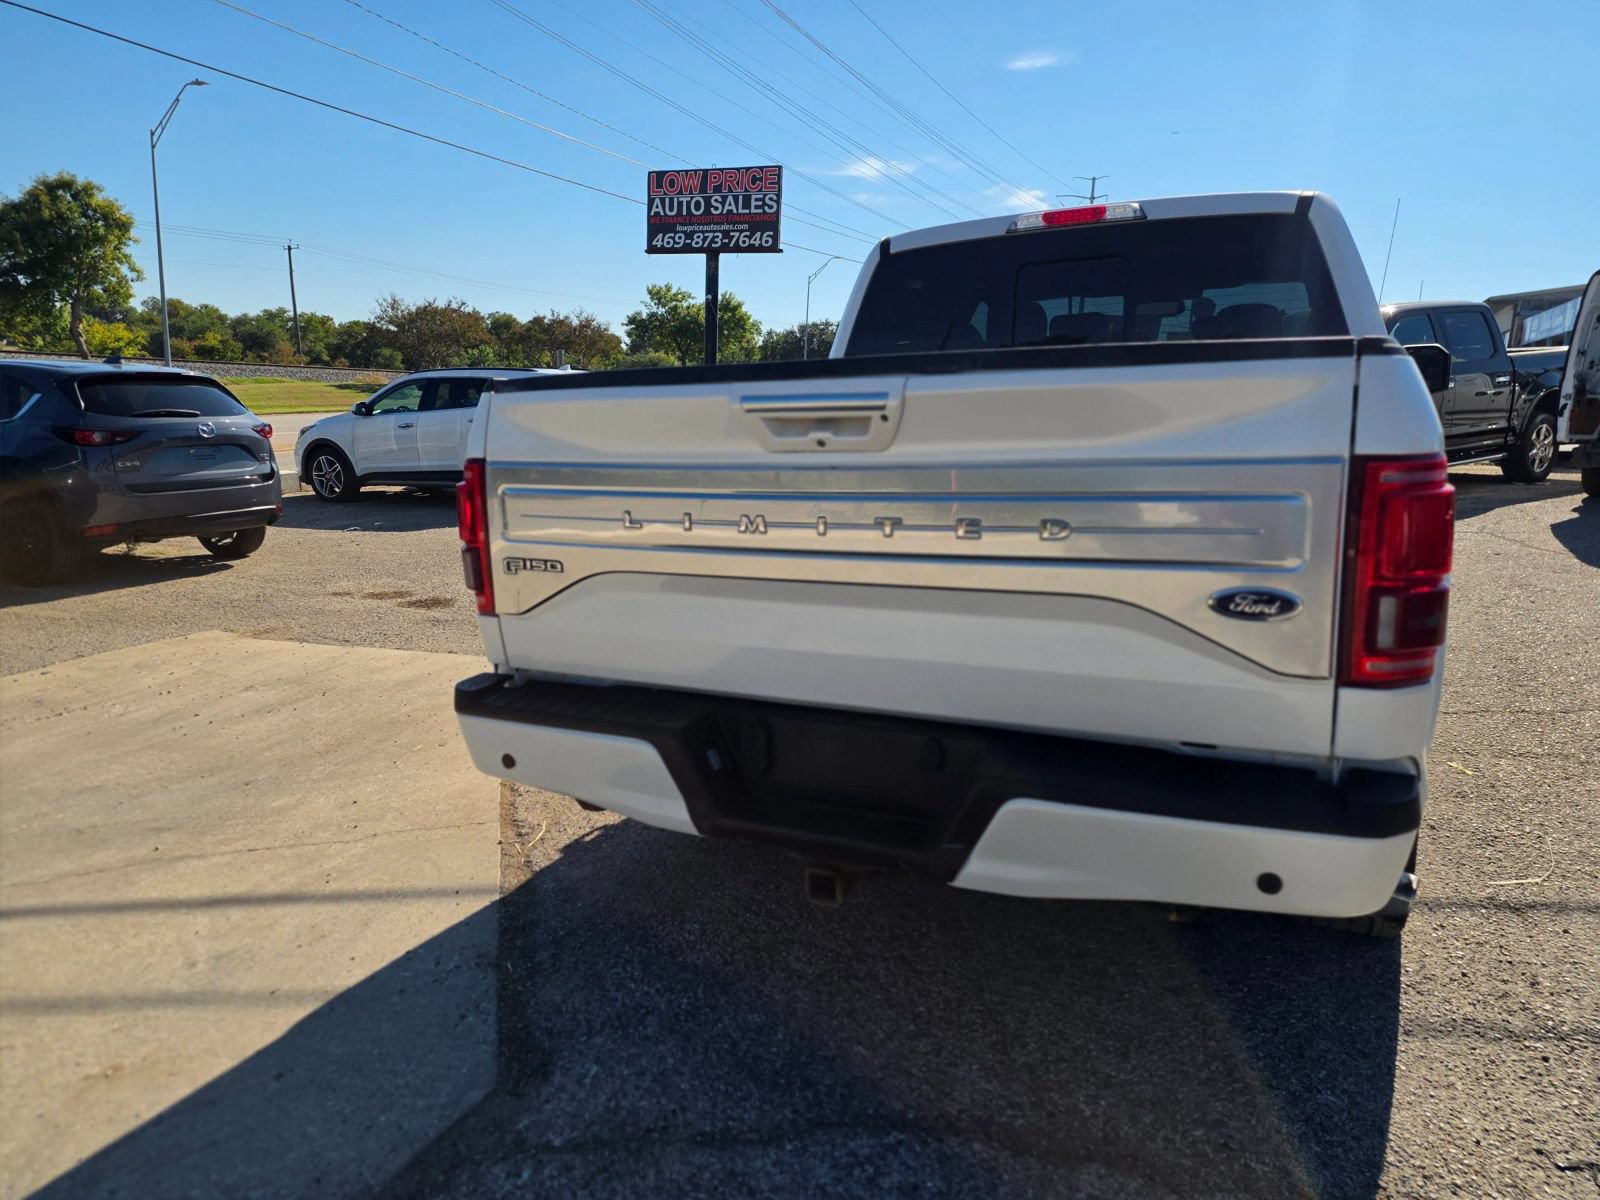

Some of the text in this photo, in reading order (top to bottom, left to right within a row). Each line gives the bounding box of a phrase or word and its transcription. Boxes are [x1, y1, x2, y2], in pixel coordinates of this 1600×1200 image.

[650, 168, 779, 196] LOW PRICE
[650, 194, 778, 216] AUTO SALES
[661, 215, 691, 223] FINANCE
[692, 214, 727, 223] NOSOTROS
[728, 213, 777, 222] FINANCIAMOS
[676, 223, 749, 232] lowpriceautosales.com
[652, 232, 773, 248] 469-873-7646
[623, 510, 1073, 541] LIMITED
[1229, 594, 1281, 614] Ford
